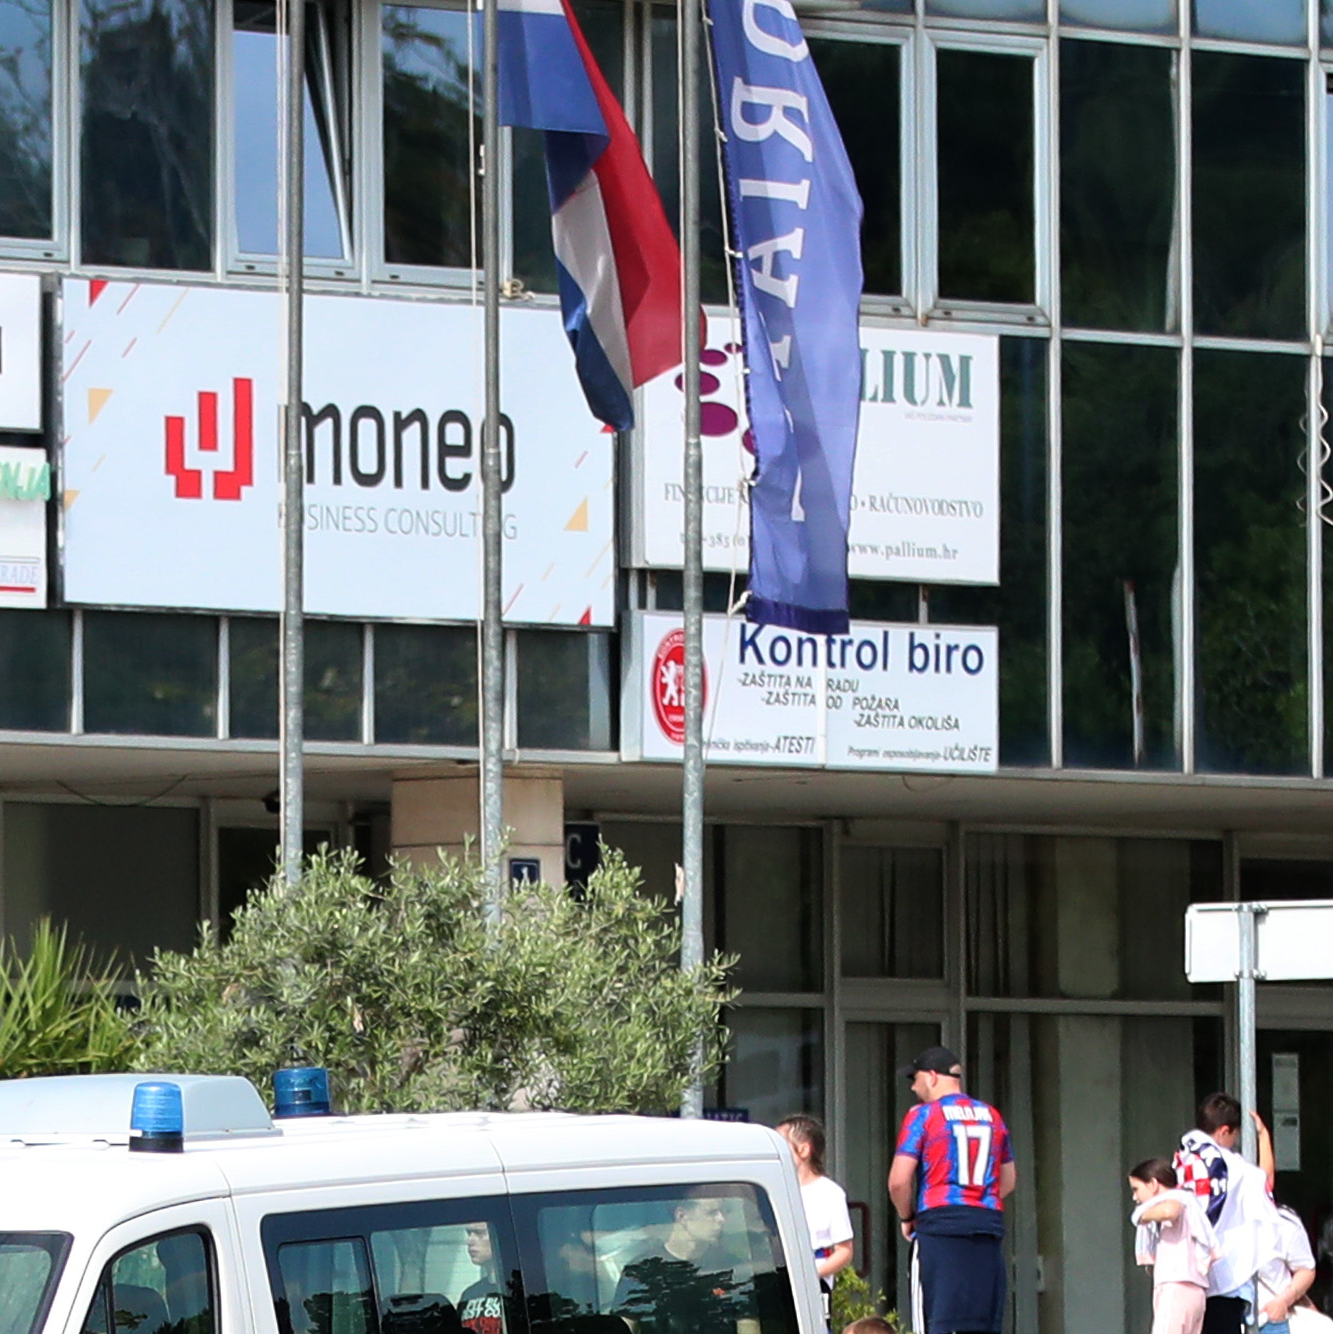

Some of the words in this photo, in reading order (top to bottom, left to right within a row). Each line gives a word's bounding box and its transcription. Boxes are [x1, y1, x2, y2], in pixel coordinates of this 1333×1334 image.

[860, 348, 974, 409] LIUM
[384, 507, 518, 540] CONSULTG
[869, 493, 984, 518] RAČUNOVODSTVO
[738, 622, 890, 671] Kontrol
[908, 630, 985, 676] biro
[825, 678, 860, 694] RADU
[952, 1123, 992, 1187] 17
